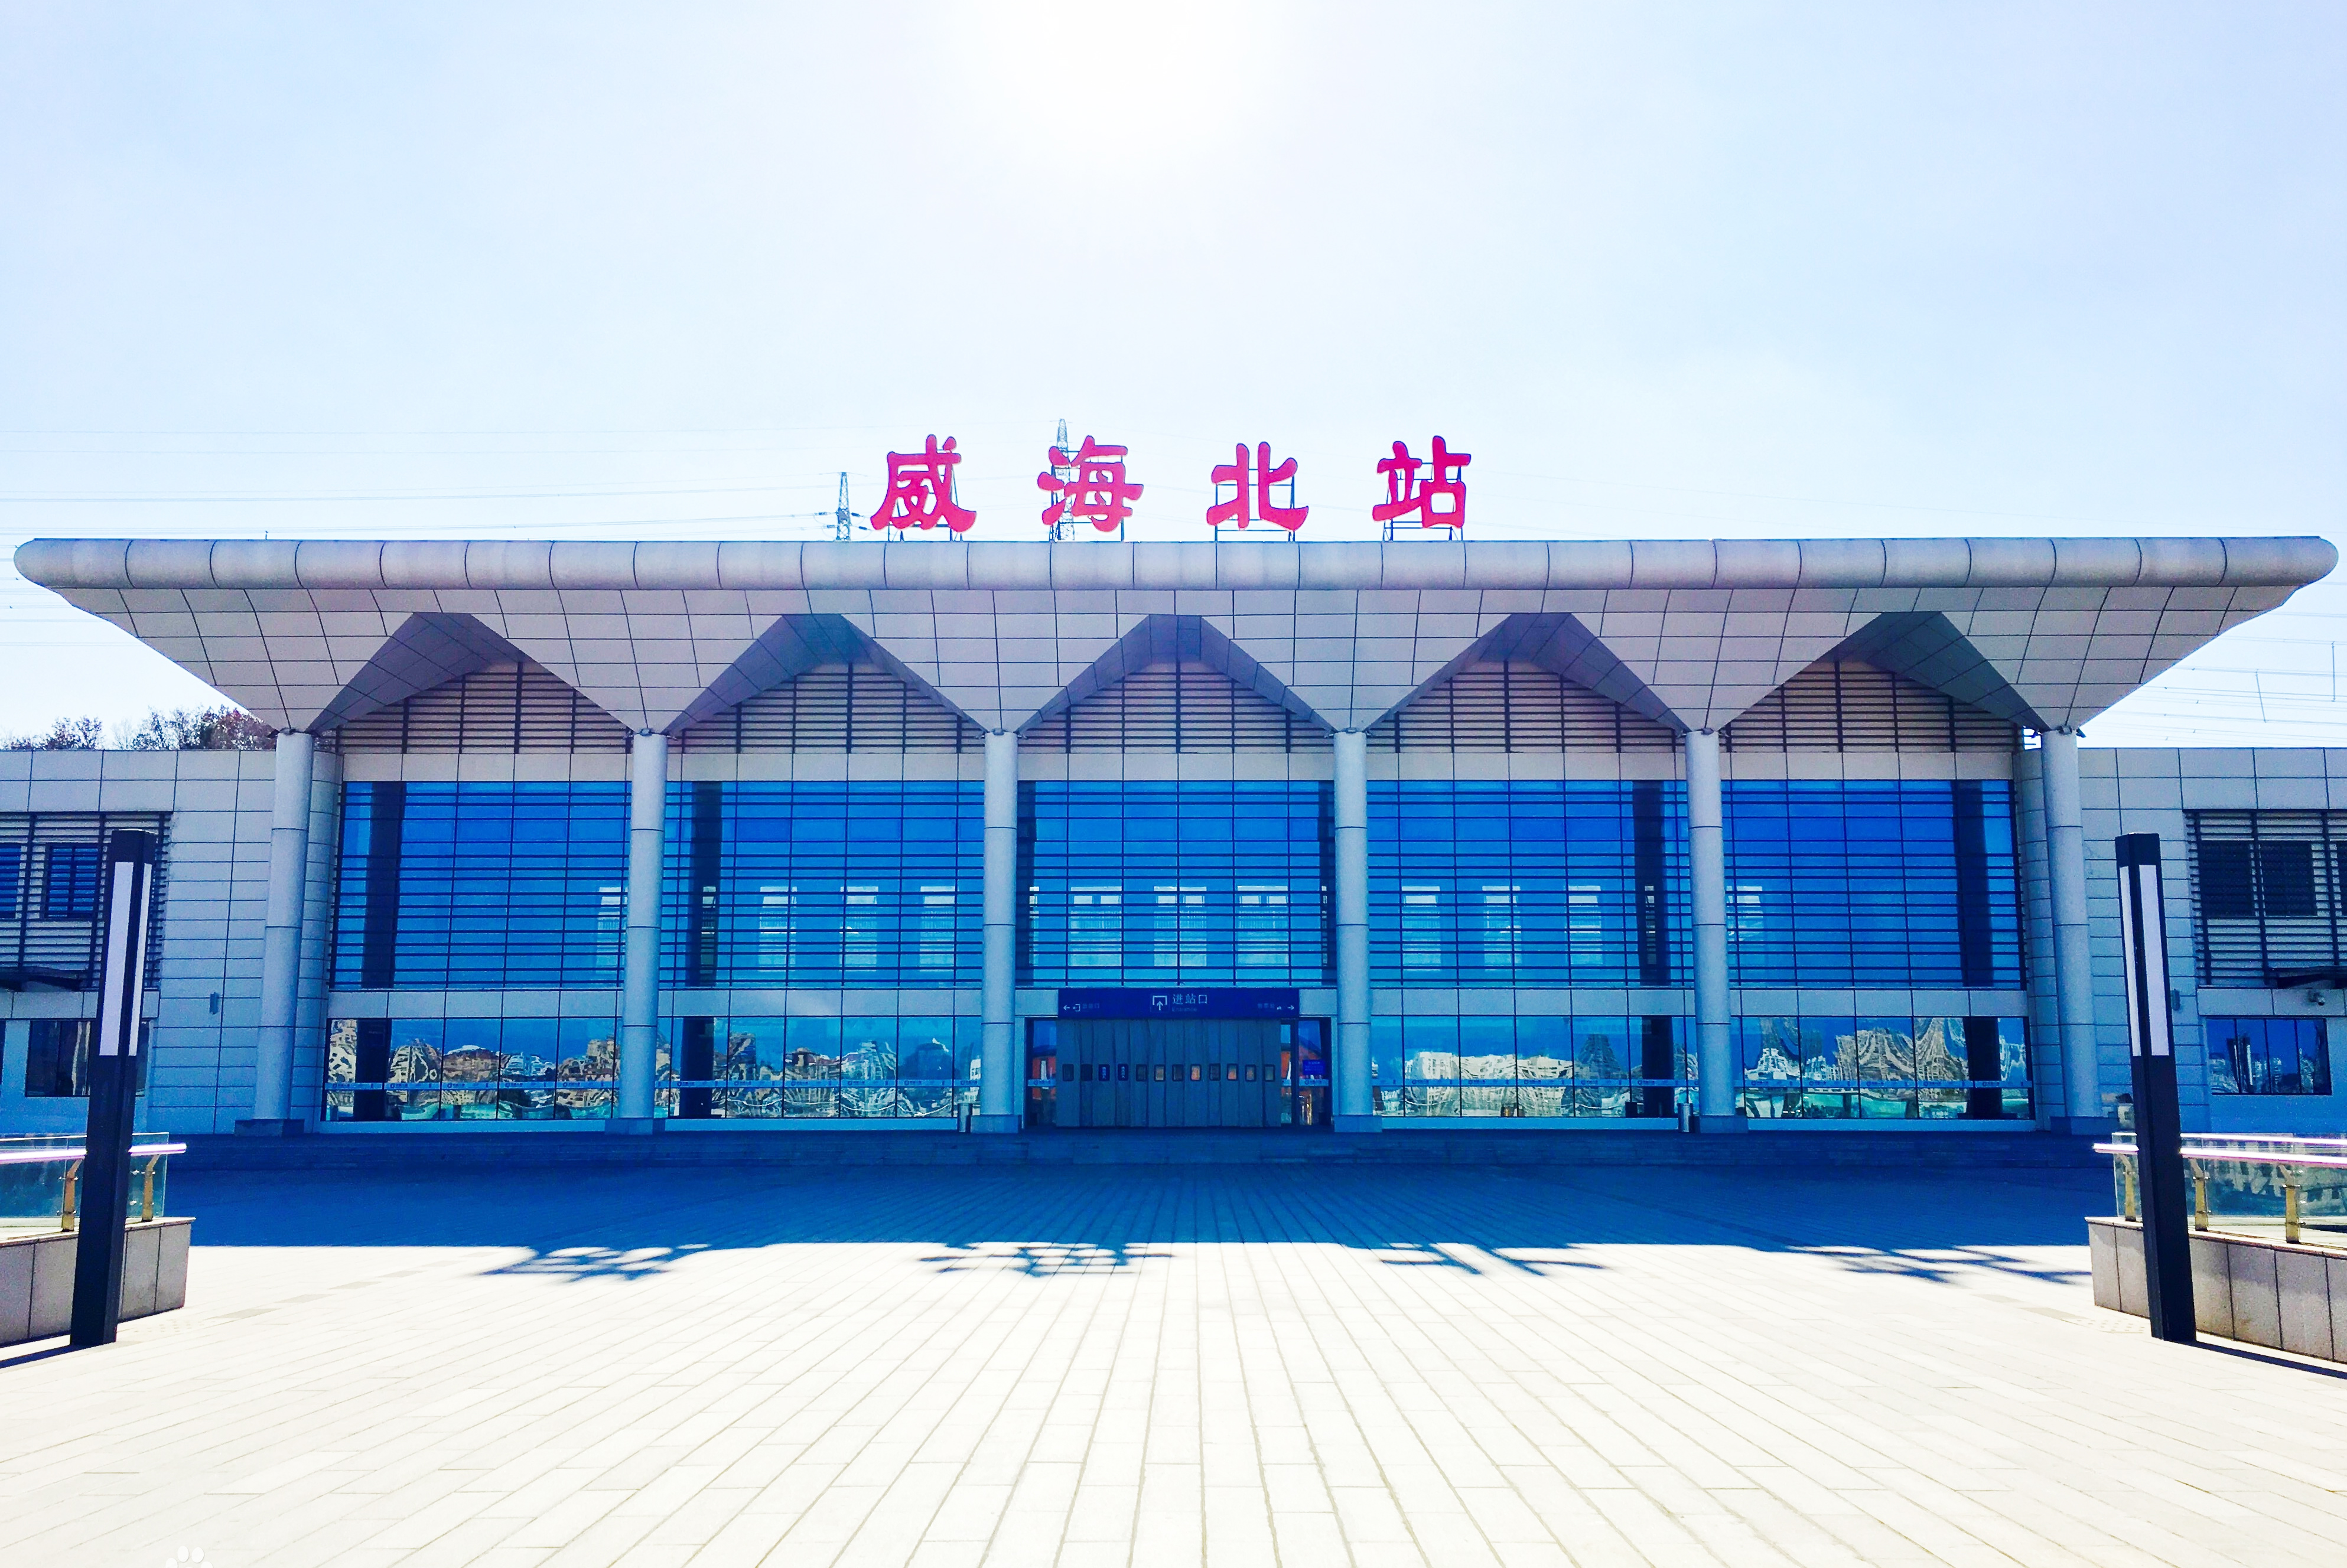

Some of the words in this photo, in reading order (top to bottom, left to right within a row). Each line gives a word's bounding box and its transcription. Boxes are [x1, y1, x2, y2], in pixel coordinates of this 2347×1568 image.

[871, 435, 1471, 533] 威海北站
[1172, 993, 1207, 1005] 进站口
